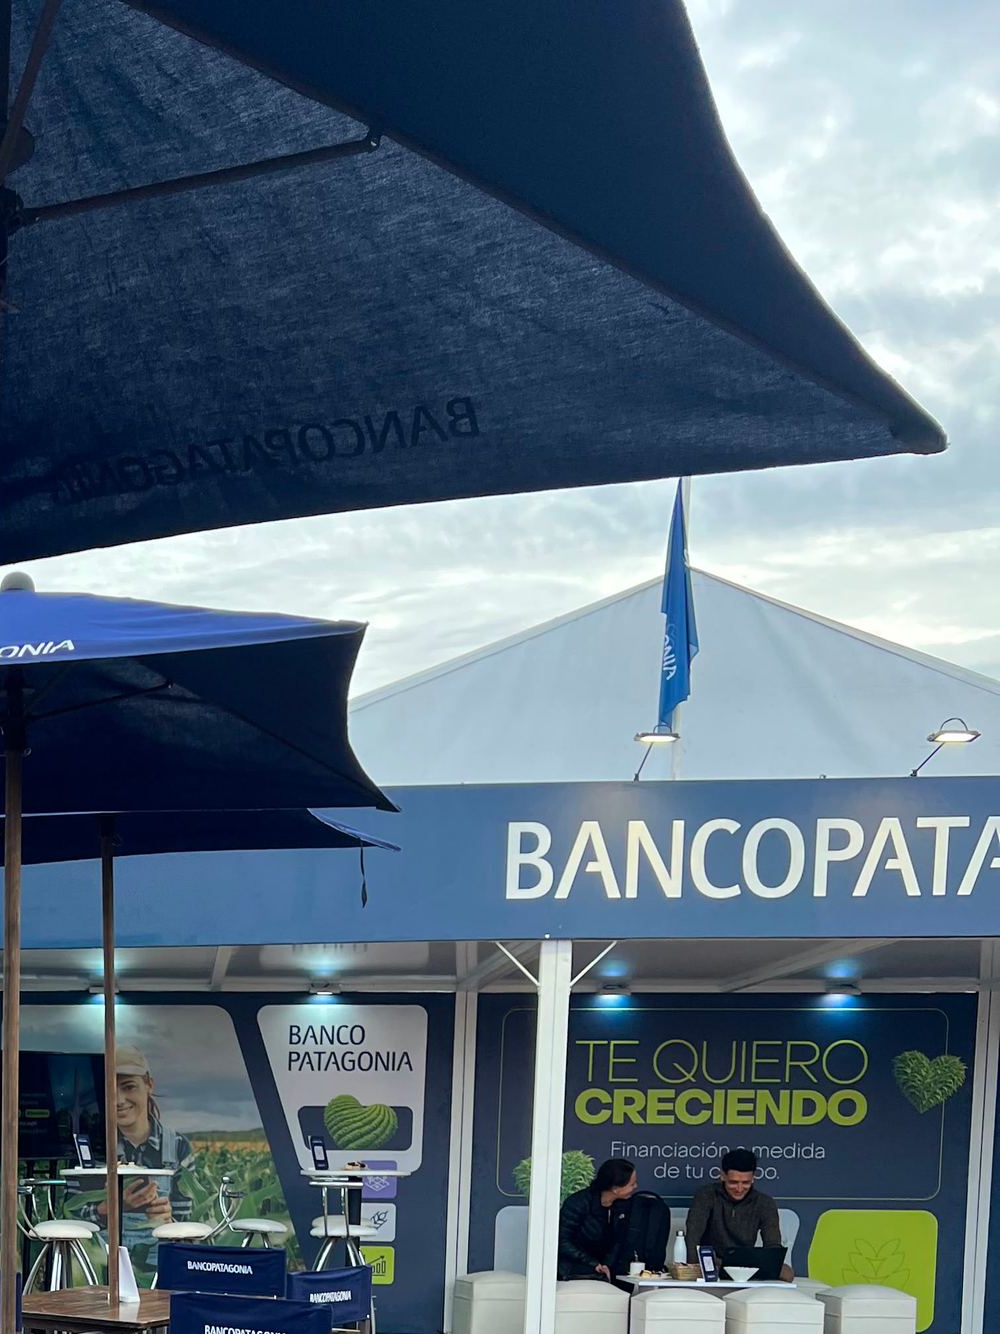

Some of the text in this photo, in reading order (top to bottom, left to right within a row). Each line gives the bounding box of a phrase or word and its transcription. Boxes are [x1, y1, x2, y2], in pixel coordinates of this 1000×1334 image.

[288, 1024, 366, 1046] BANCO
[287, 1050, 414, 1073] PATAGONIA
[575, 1038, 869, 1085] TE QUIERO
[574, 1087, 868, 1127] CRECIENDO
[610, 1141, 826, 1160] Financiación medida
[653, 1162, 680, 1179] de
[685, 1163, 704, 1179] tu
[187, 1260, 254, 1275] BANCOPATAGONIA
[309, 1290, 352, 1303] BANCOPATAGONIA
